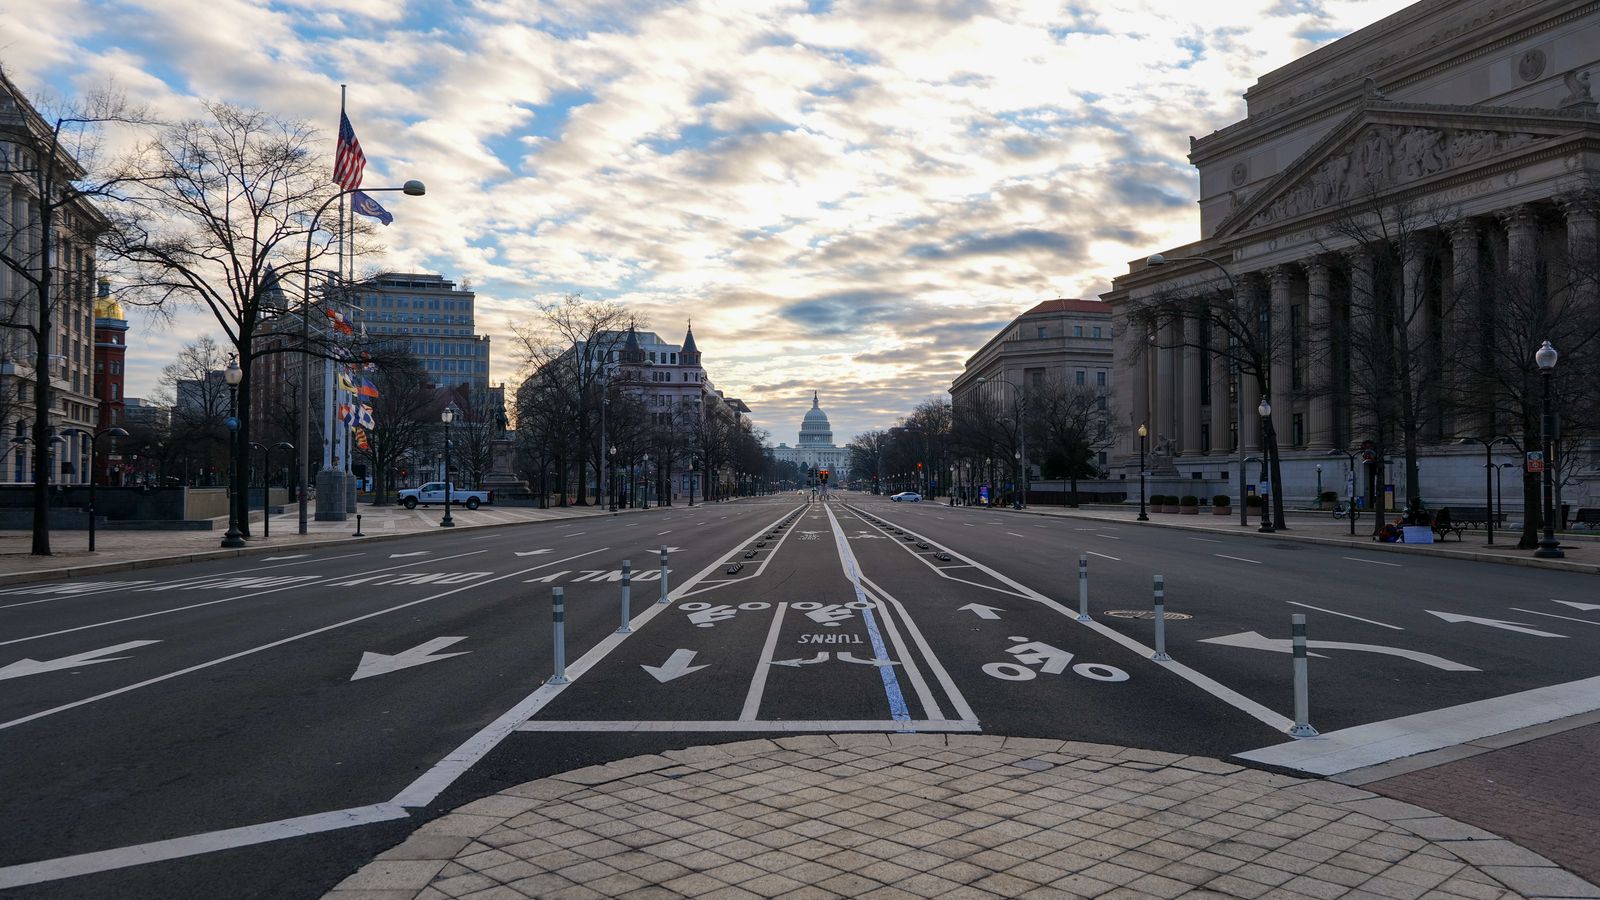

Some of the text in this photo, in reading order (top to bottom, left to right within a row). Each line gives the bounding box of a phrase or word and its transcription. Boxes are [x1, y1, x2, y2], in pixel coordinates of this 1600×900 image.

[1443, 181, 1494, 201] AMERICA
[324, 572, 494, 586] ONLY
[522, 569, 673, 582] ONLY
[797, 633, 864, 644] TURNS
